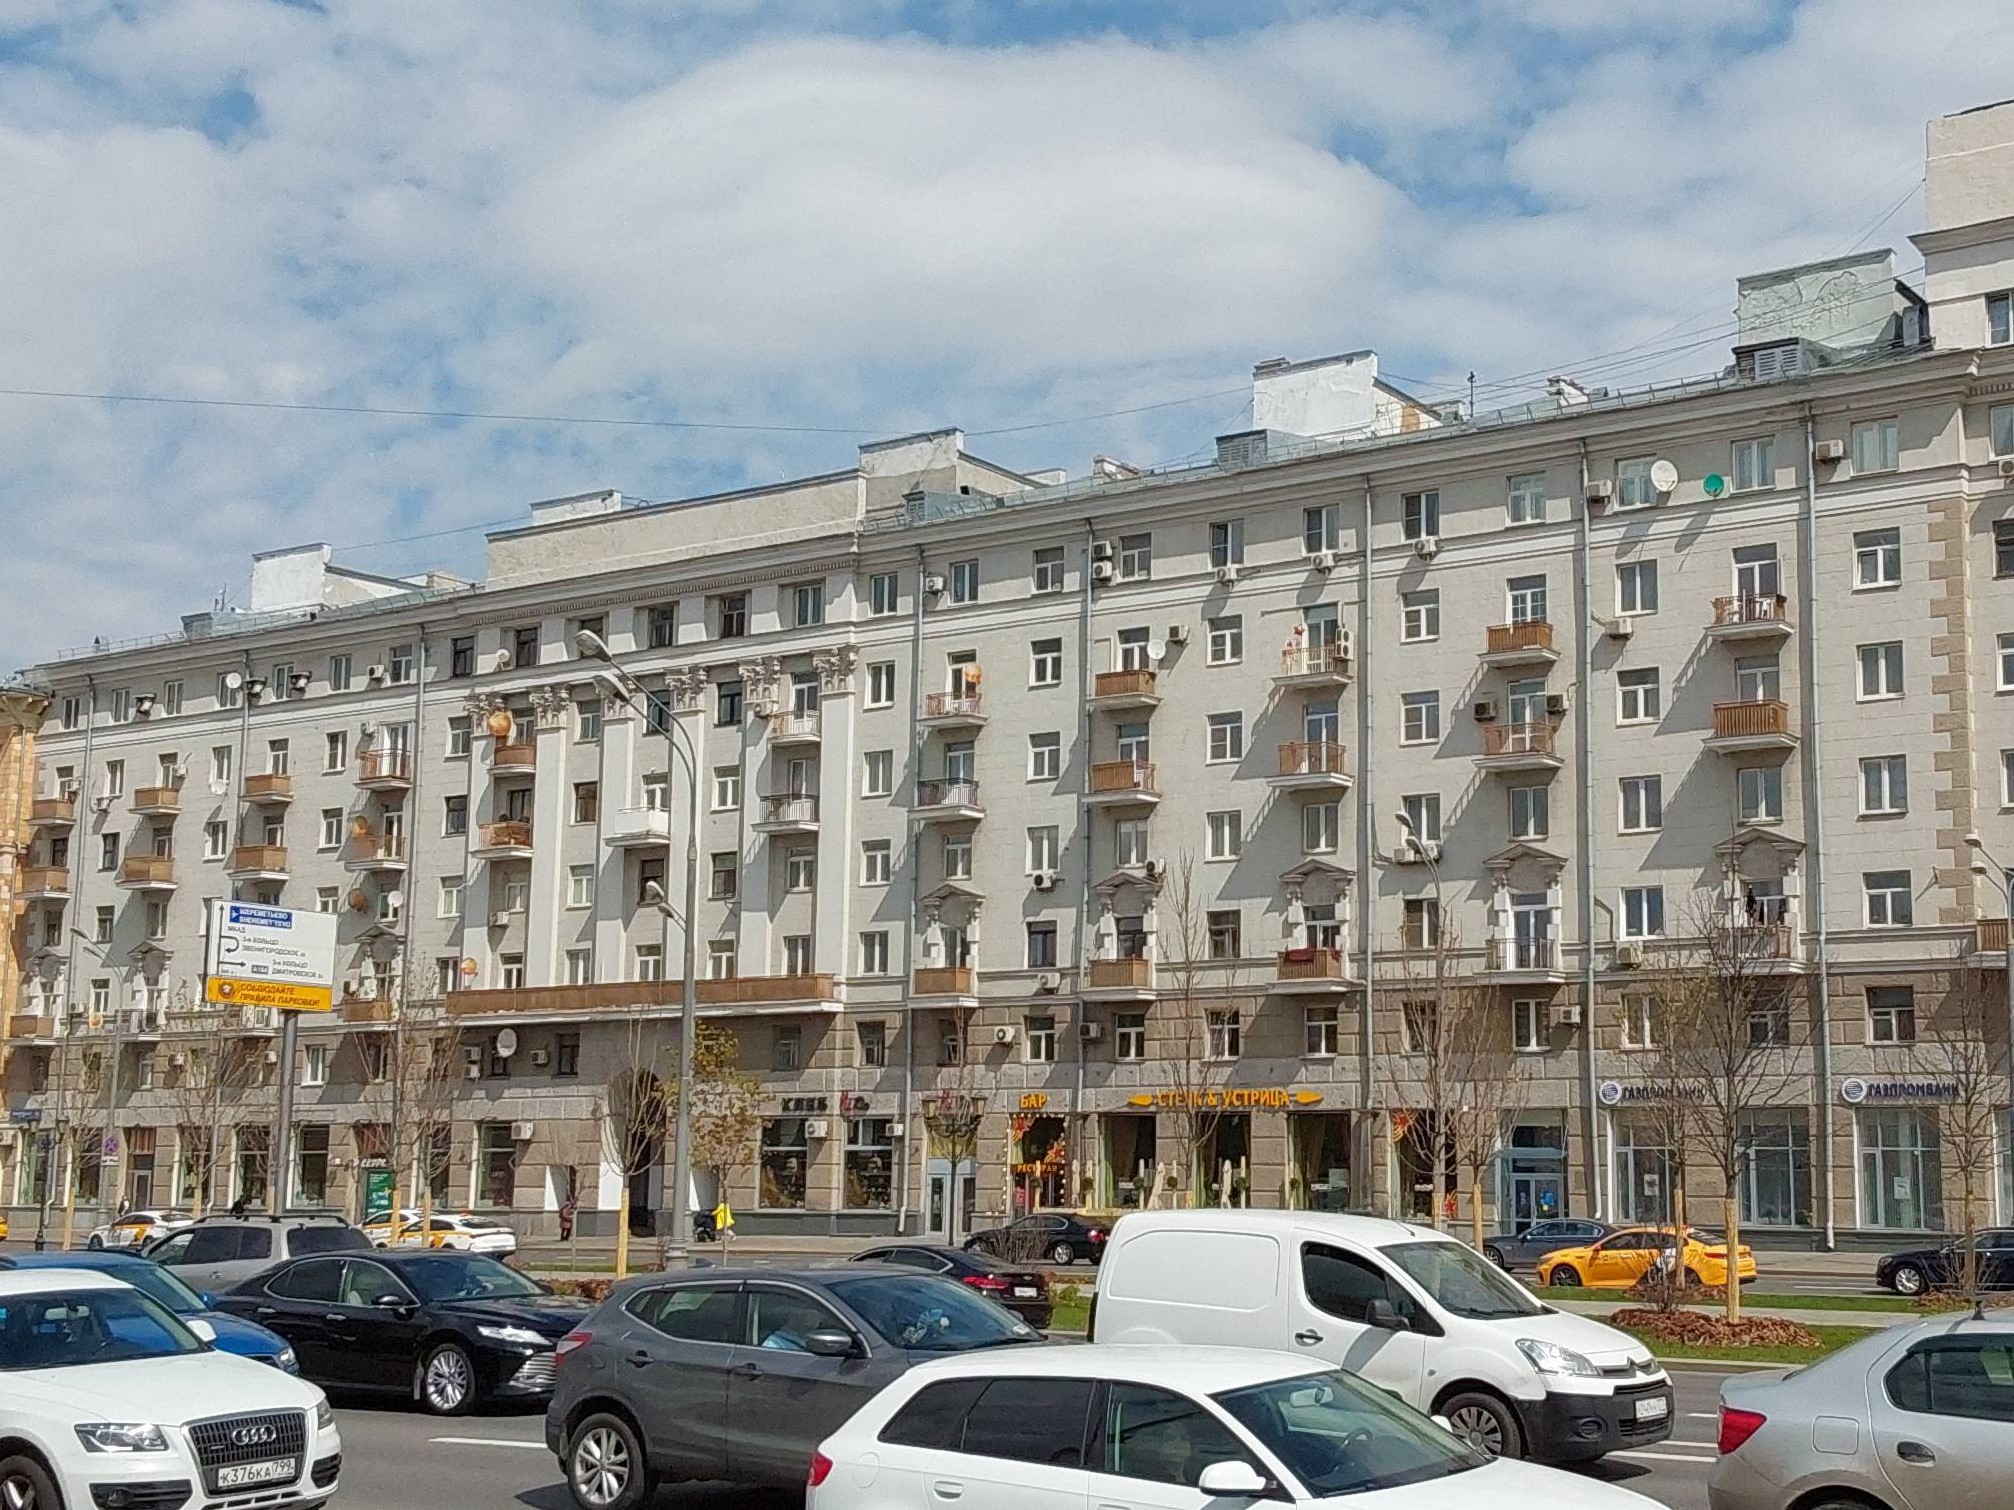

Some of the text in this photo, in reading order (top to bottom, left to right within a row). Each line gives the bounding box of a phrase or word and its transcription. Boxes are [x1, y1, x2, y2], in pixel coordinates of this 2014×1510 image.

[240, 983, 295, 996] СОБЛЮДАЙТЕ
[240, 993, 276, 1003] ПРАВИЛА
[1019, 1092, 1050, 1110] БАР
[1222, 1089, 1291, 1109] УСТРИЦА
